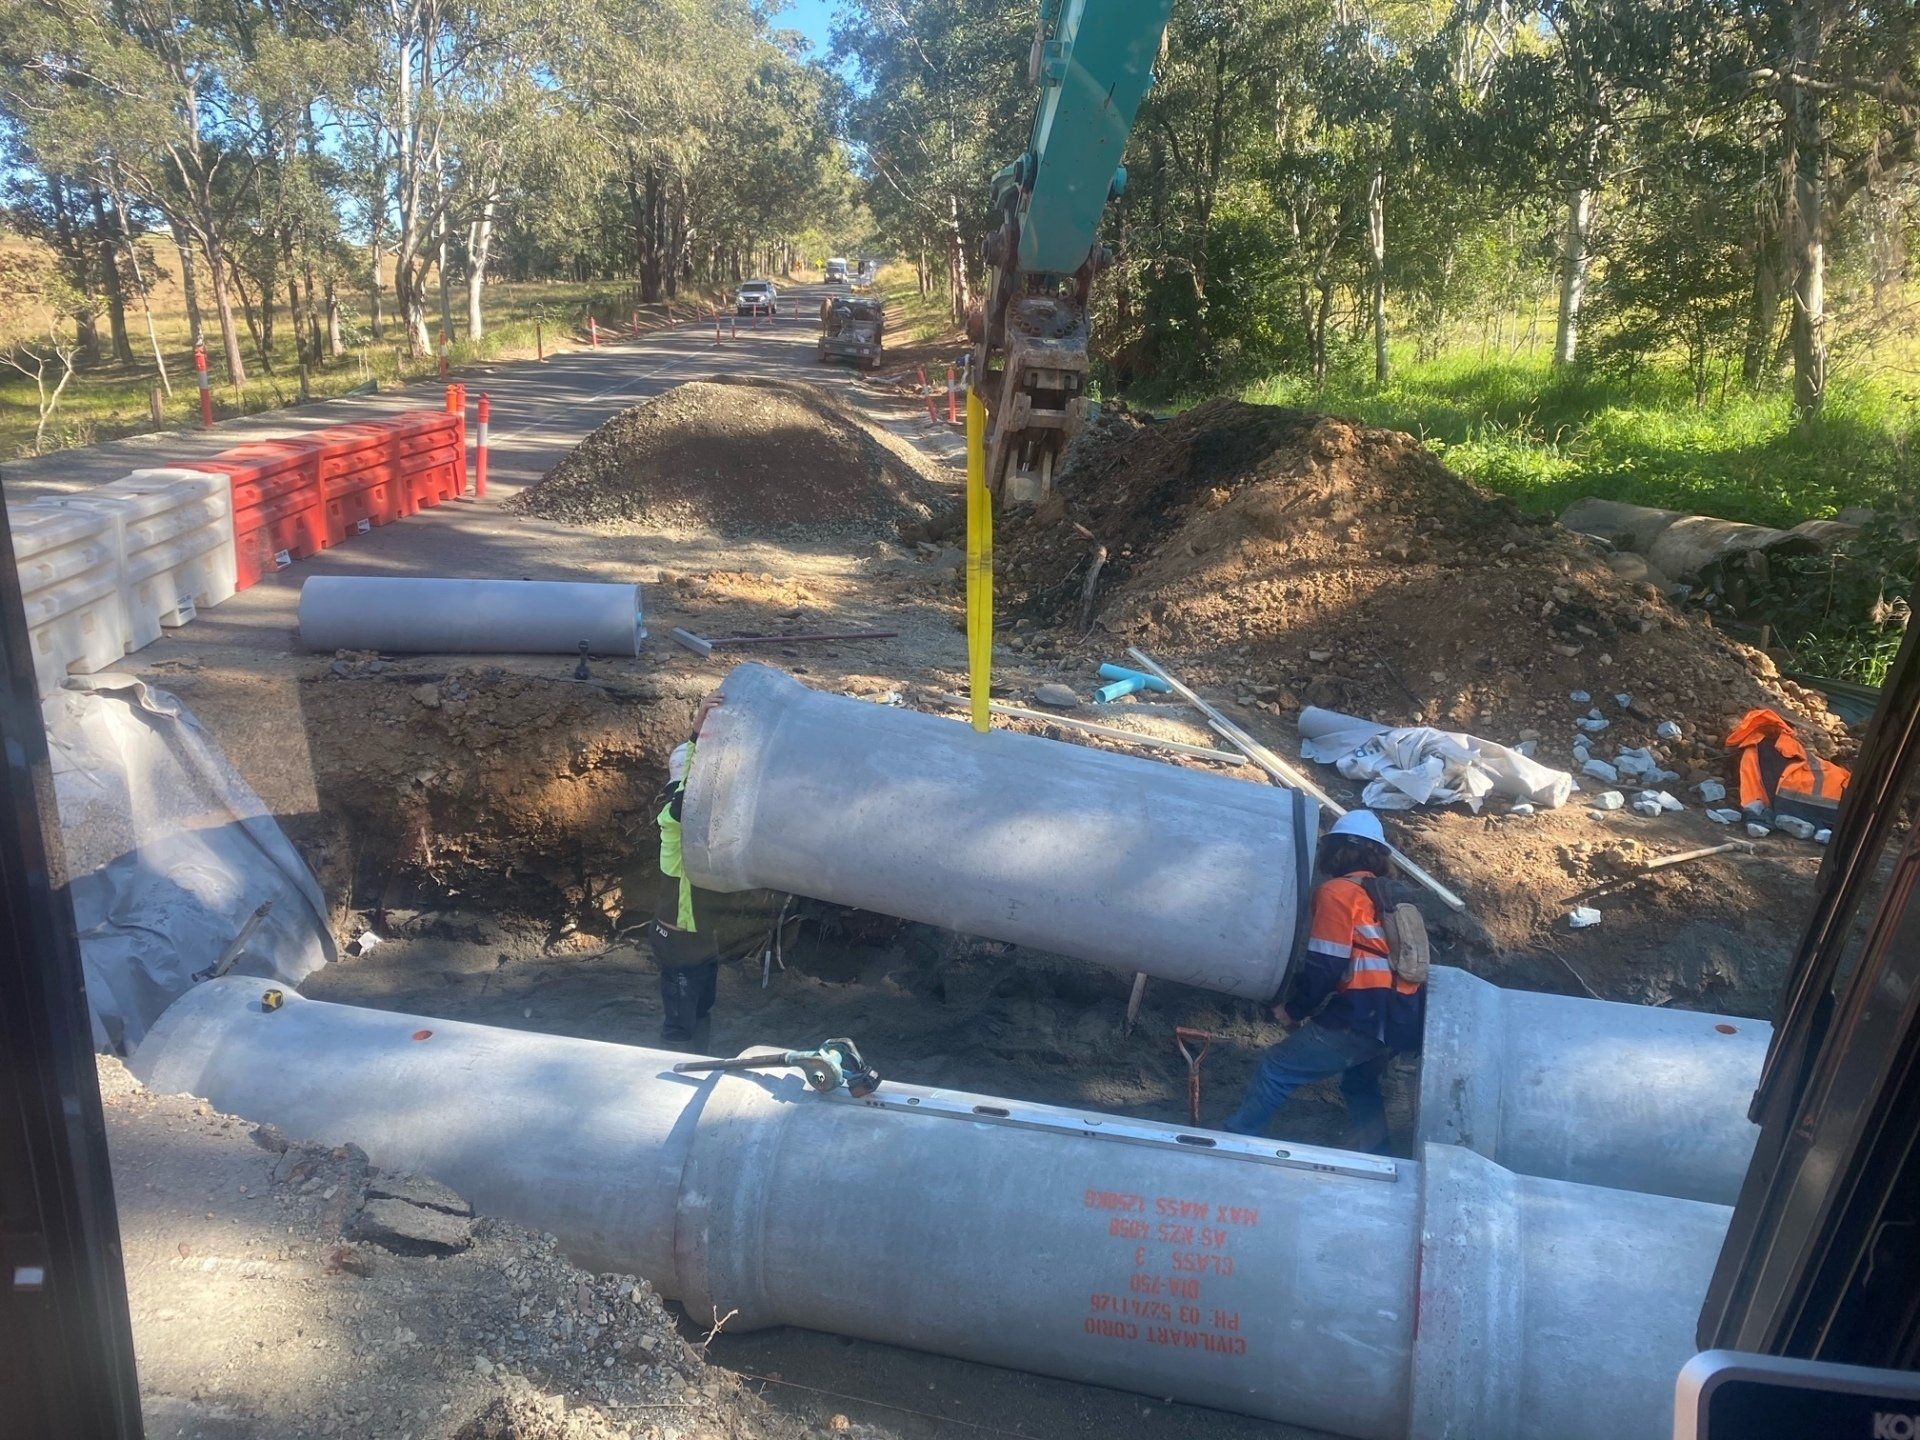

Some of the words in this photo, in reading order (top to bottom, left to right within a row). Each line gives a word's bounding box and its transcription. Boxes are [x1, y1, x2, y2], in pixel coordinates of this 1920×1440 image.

[1156, 1198, 1209, 1220] MASS
[1217, 1205, 1259, 1227] MAX
[1202, 1228, 1228, 1248] AS
[1135, 1246, 1147, 1266] 3
[1172, 1251, 1234, 1276] CLASS
[1180, 1305, 1201, 1326] 03
[1084, 1318, 1139, 1340] CORIO
[1146, 1326, 1248, 1355] CIVILMART
[1873, 1411, 1920, 1440] KO
